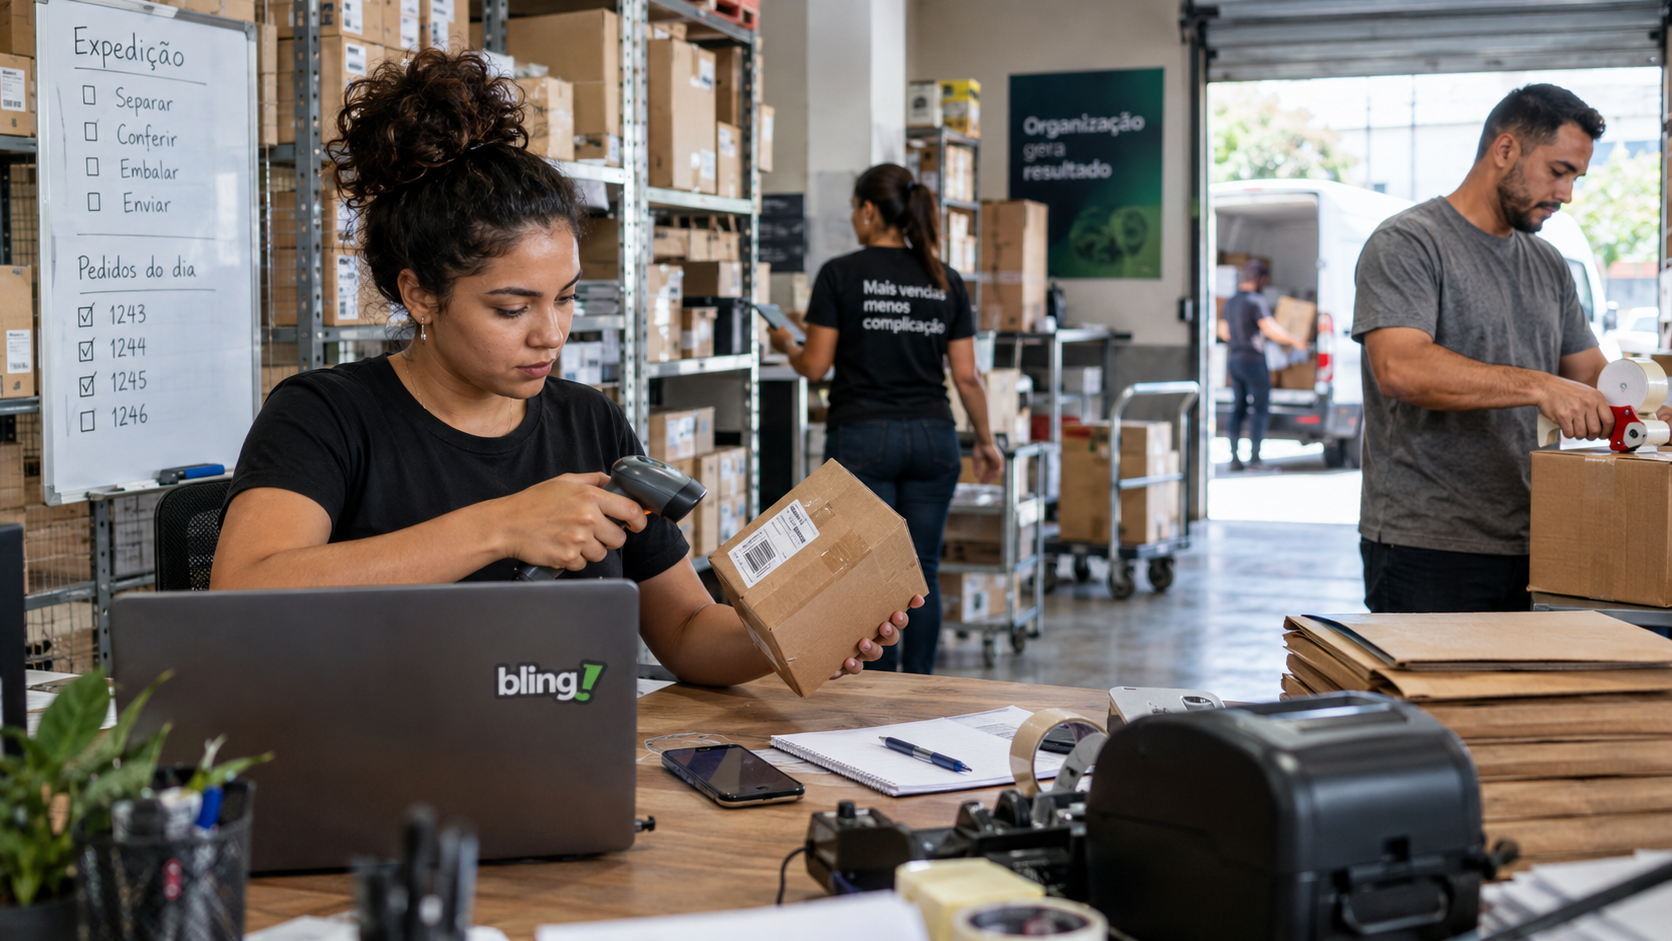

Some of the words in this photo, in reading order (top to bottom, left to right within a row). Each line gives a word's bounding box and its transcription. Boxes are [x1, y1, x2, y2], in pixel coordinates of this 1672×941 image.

[74, 26, 185, 71] Expedição
[115, 86, 174, 117] Separar
[1022, 111, 1146, 139] Organização
[117, 123, 178, 152] Conferir
[1022, 141, 1067, 162] gera
[120, 158, 179, 180] Embalar
[1022, 158, 1113, 181] resultado
[123, 191, 172, 213] Enviar
[77, 254, 137, 280] Pedidos
[145, 254, 164, 278] do
[172, 254, 197, 278] dia
[863, 279, 897, 297] Mais
[898, 283, 947, 301] vendas
[110, 304, 147, 325] 1243
[863, 300, 911, 314] menos
[862, 316, 946, 337] complicação
[110, 337, 146, 359] 1244
[111, 370, 147, 393] 1245
[112, 403, 148, 428] 1246
[497, 663, 603, 701] bling!
